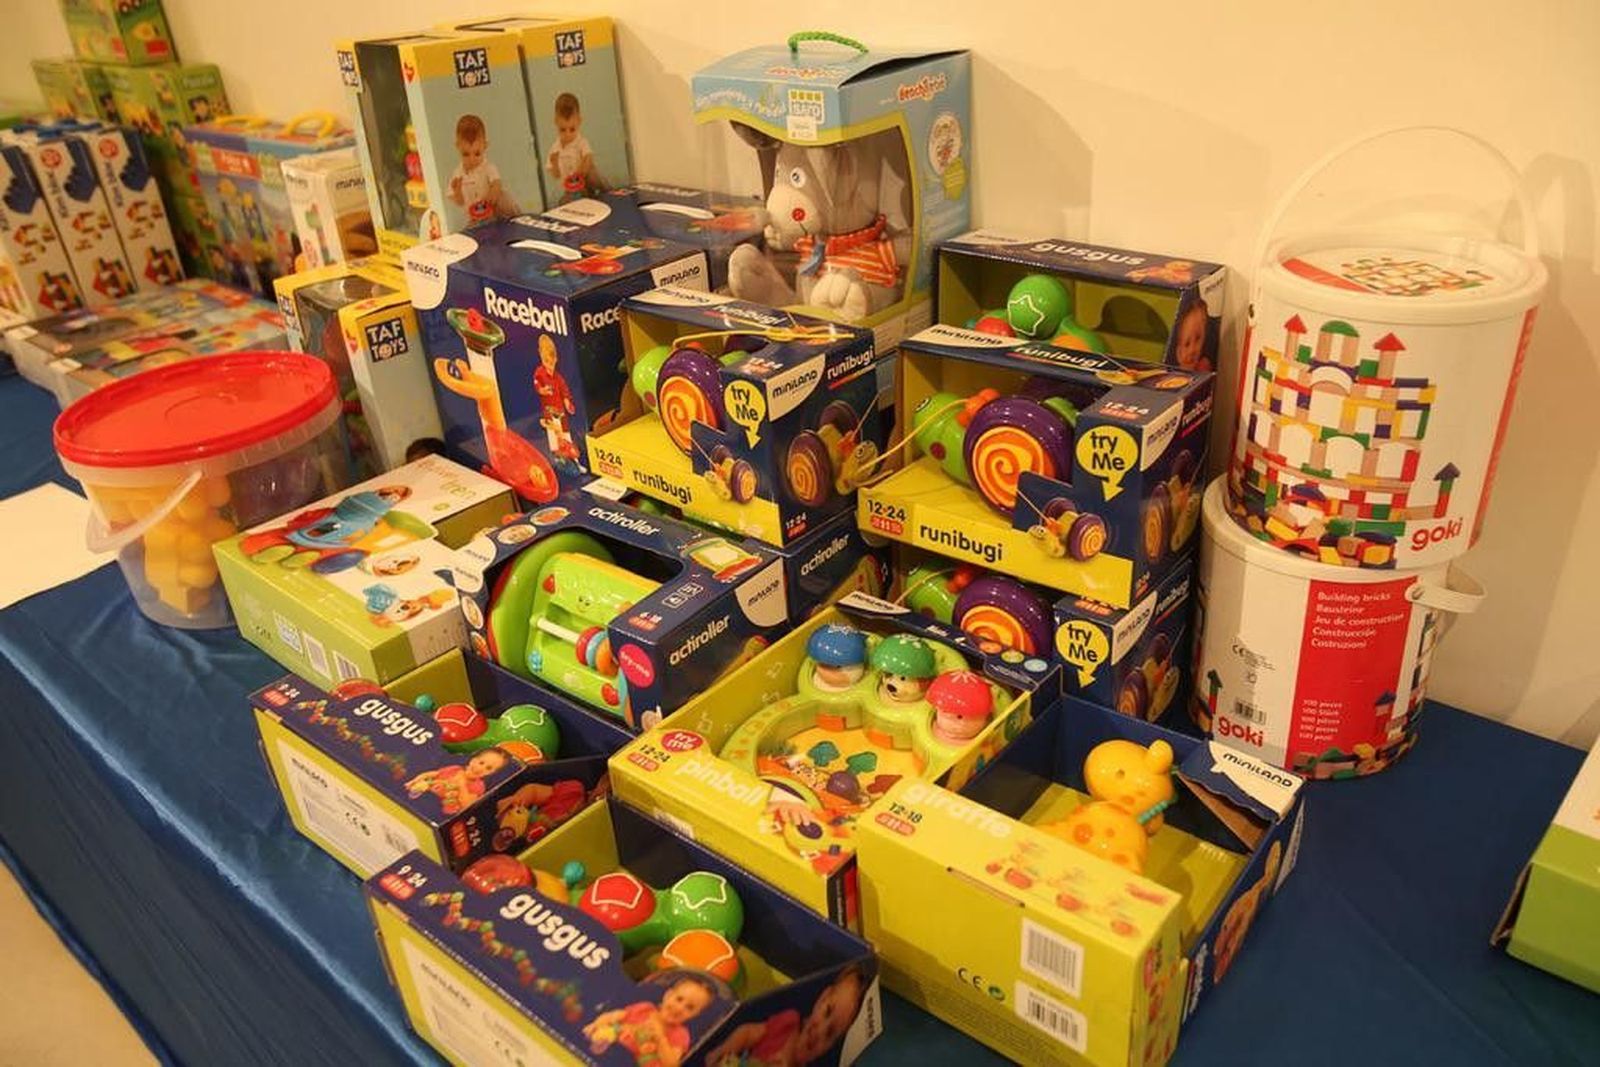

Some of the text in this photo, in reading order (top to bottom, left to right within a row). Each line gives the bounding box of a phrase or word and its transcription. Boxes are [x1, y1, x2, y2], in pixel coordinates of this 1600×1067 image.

[556, 32, 583, 51] TAF
[455, 50, 486, 70] TAF
[559, 49, 585, 68] TOYS
[459, 67, 489, 87] TOYS
[1029, 239, 1147, 266] gusgus
[483, 286, 569, 337] Raceball
[366, 320, 402, 345] TAF
[371, 338, 406, 360] TOYS
[1014, 346, 1108, 370] runibugi
[826, 345, 875, 380] runibugi
[731, 384, 751, 406] try
[735, 403, 759, 421] Me
[1089, 431, 1119, 454] try
[1091, 452, 1126, 471] Me
[632, 469, 693, 504] runibugi
[588, 506, 661, 536] actiroller
[1410, 516, 1464, 551] goki
[801, 533, 850, 576] actiroller
[920, 524, 1003, 563] runibugi
[669, 615, 730, 666] actiroller
[1067, 623, 1093, 648] try
[1069, 642, 1098, 662] Me
[353, 699, 435, 746] gusgus
[1217, 716, 1264, 748] goki
[674, 758, 765, 807] pinball
[499, 893, 611, 969] gusgus
